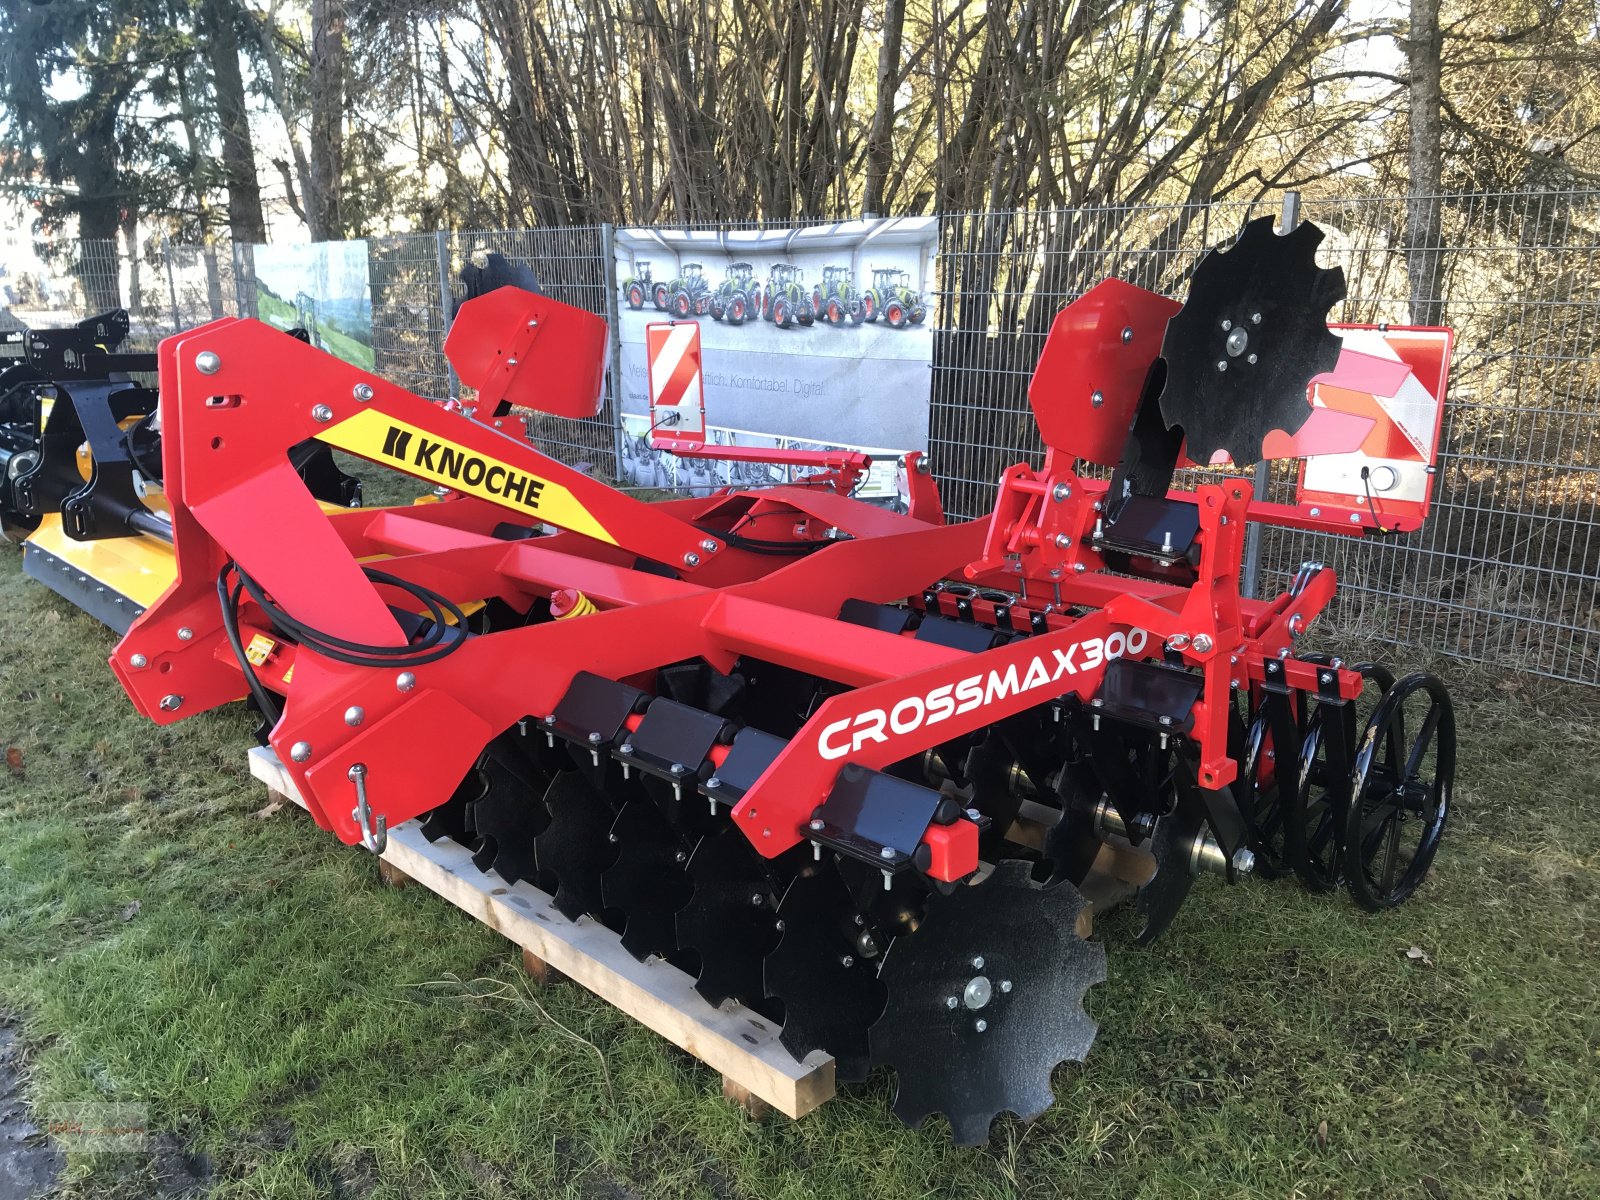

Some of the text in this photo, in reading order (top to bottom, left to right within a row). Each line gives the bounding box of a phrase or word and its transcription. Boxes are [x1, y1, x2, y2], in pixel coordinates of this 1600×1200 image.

[702, 371, 728, 387] ftlich.
[730, 374, 790, 393] Komfortabel.
[413, 437, 545, 509] KNOCHE
[818, 625, 1148, 760] CROSSMAX300
